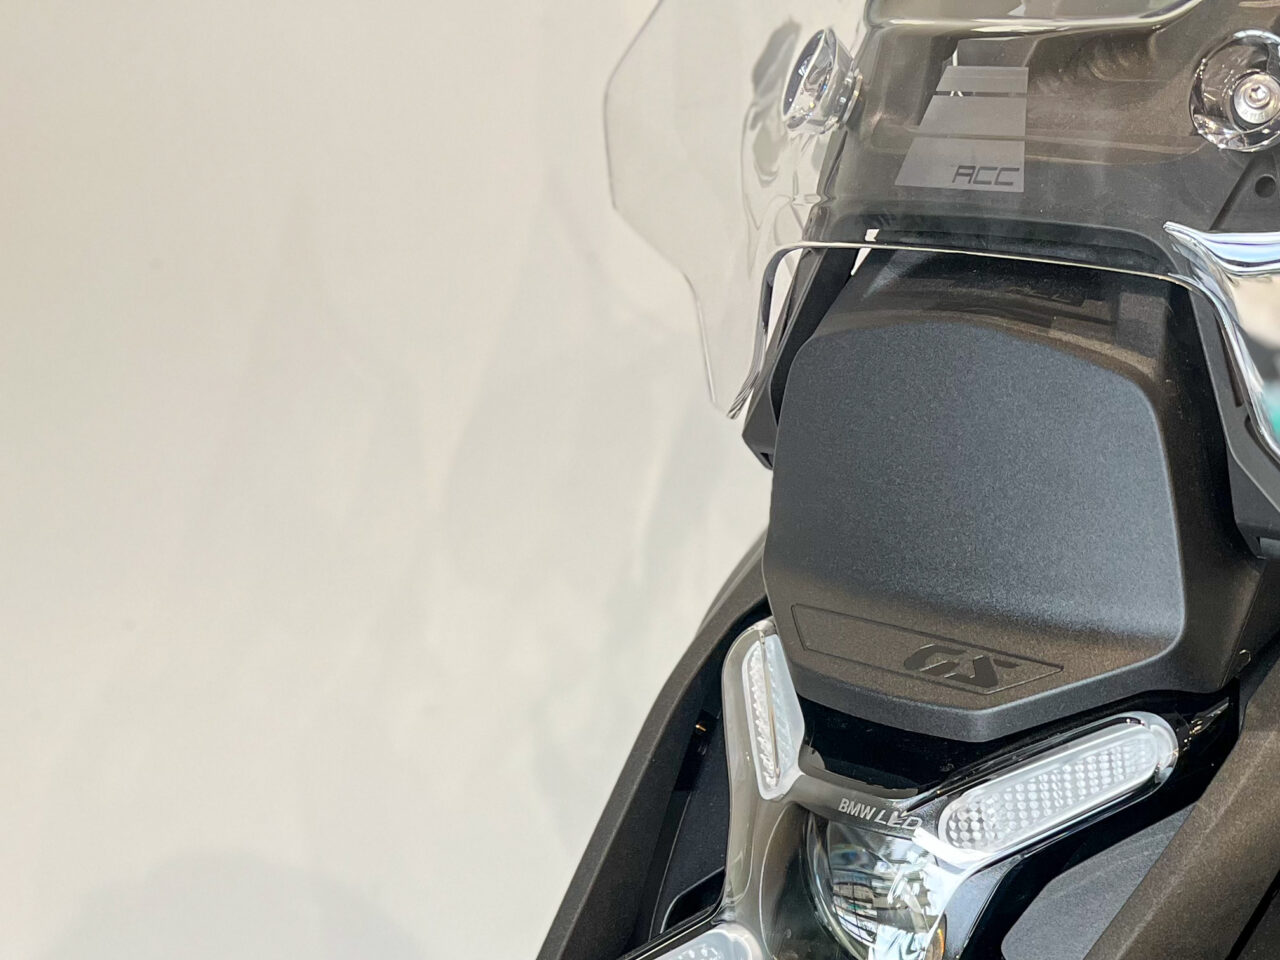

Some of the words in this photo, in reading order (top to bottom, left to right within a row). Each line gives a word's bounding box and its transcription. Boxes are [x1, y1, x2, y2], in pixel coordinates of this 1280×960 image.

[951, 164, 1020, 186] ACC
[903, 643, 1020, 689] GS
[838, 797, 877, 821] BMW
[873, 809, 923, 830] LED
